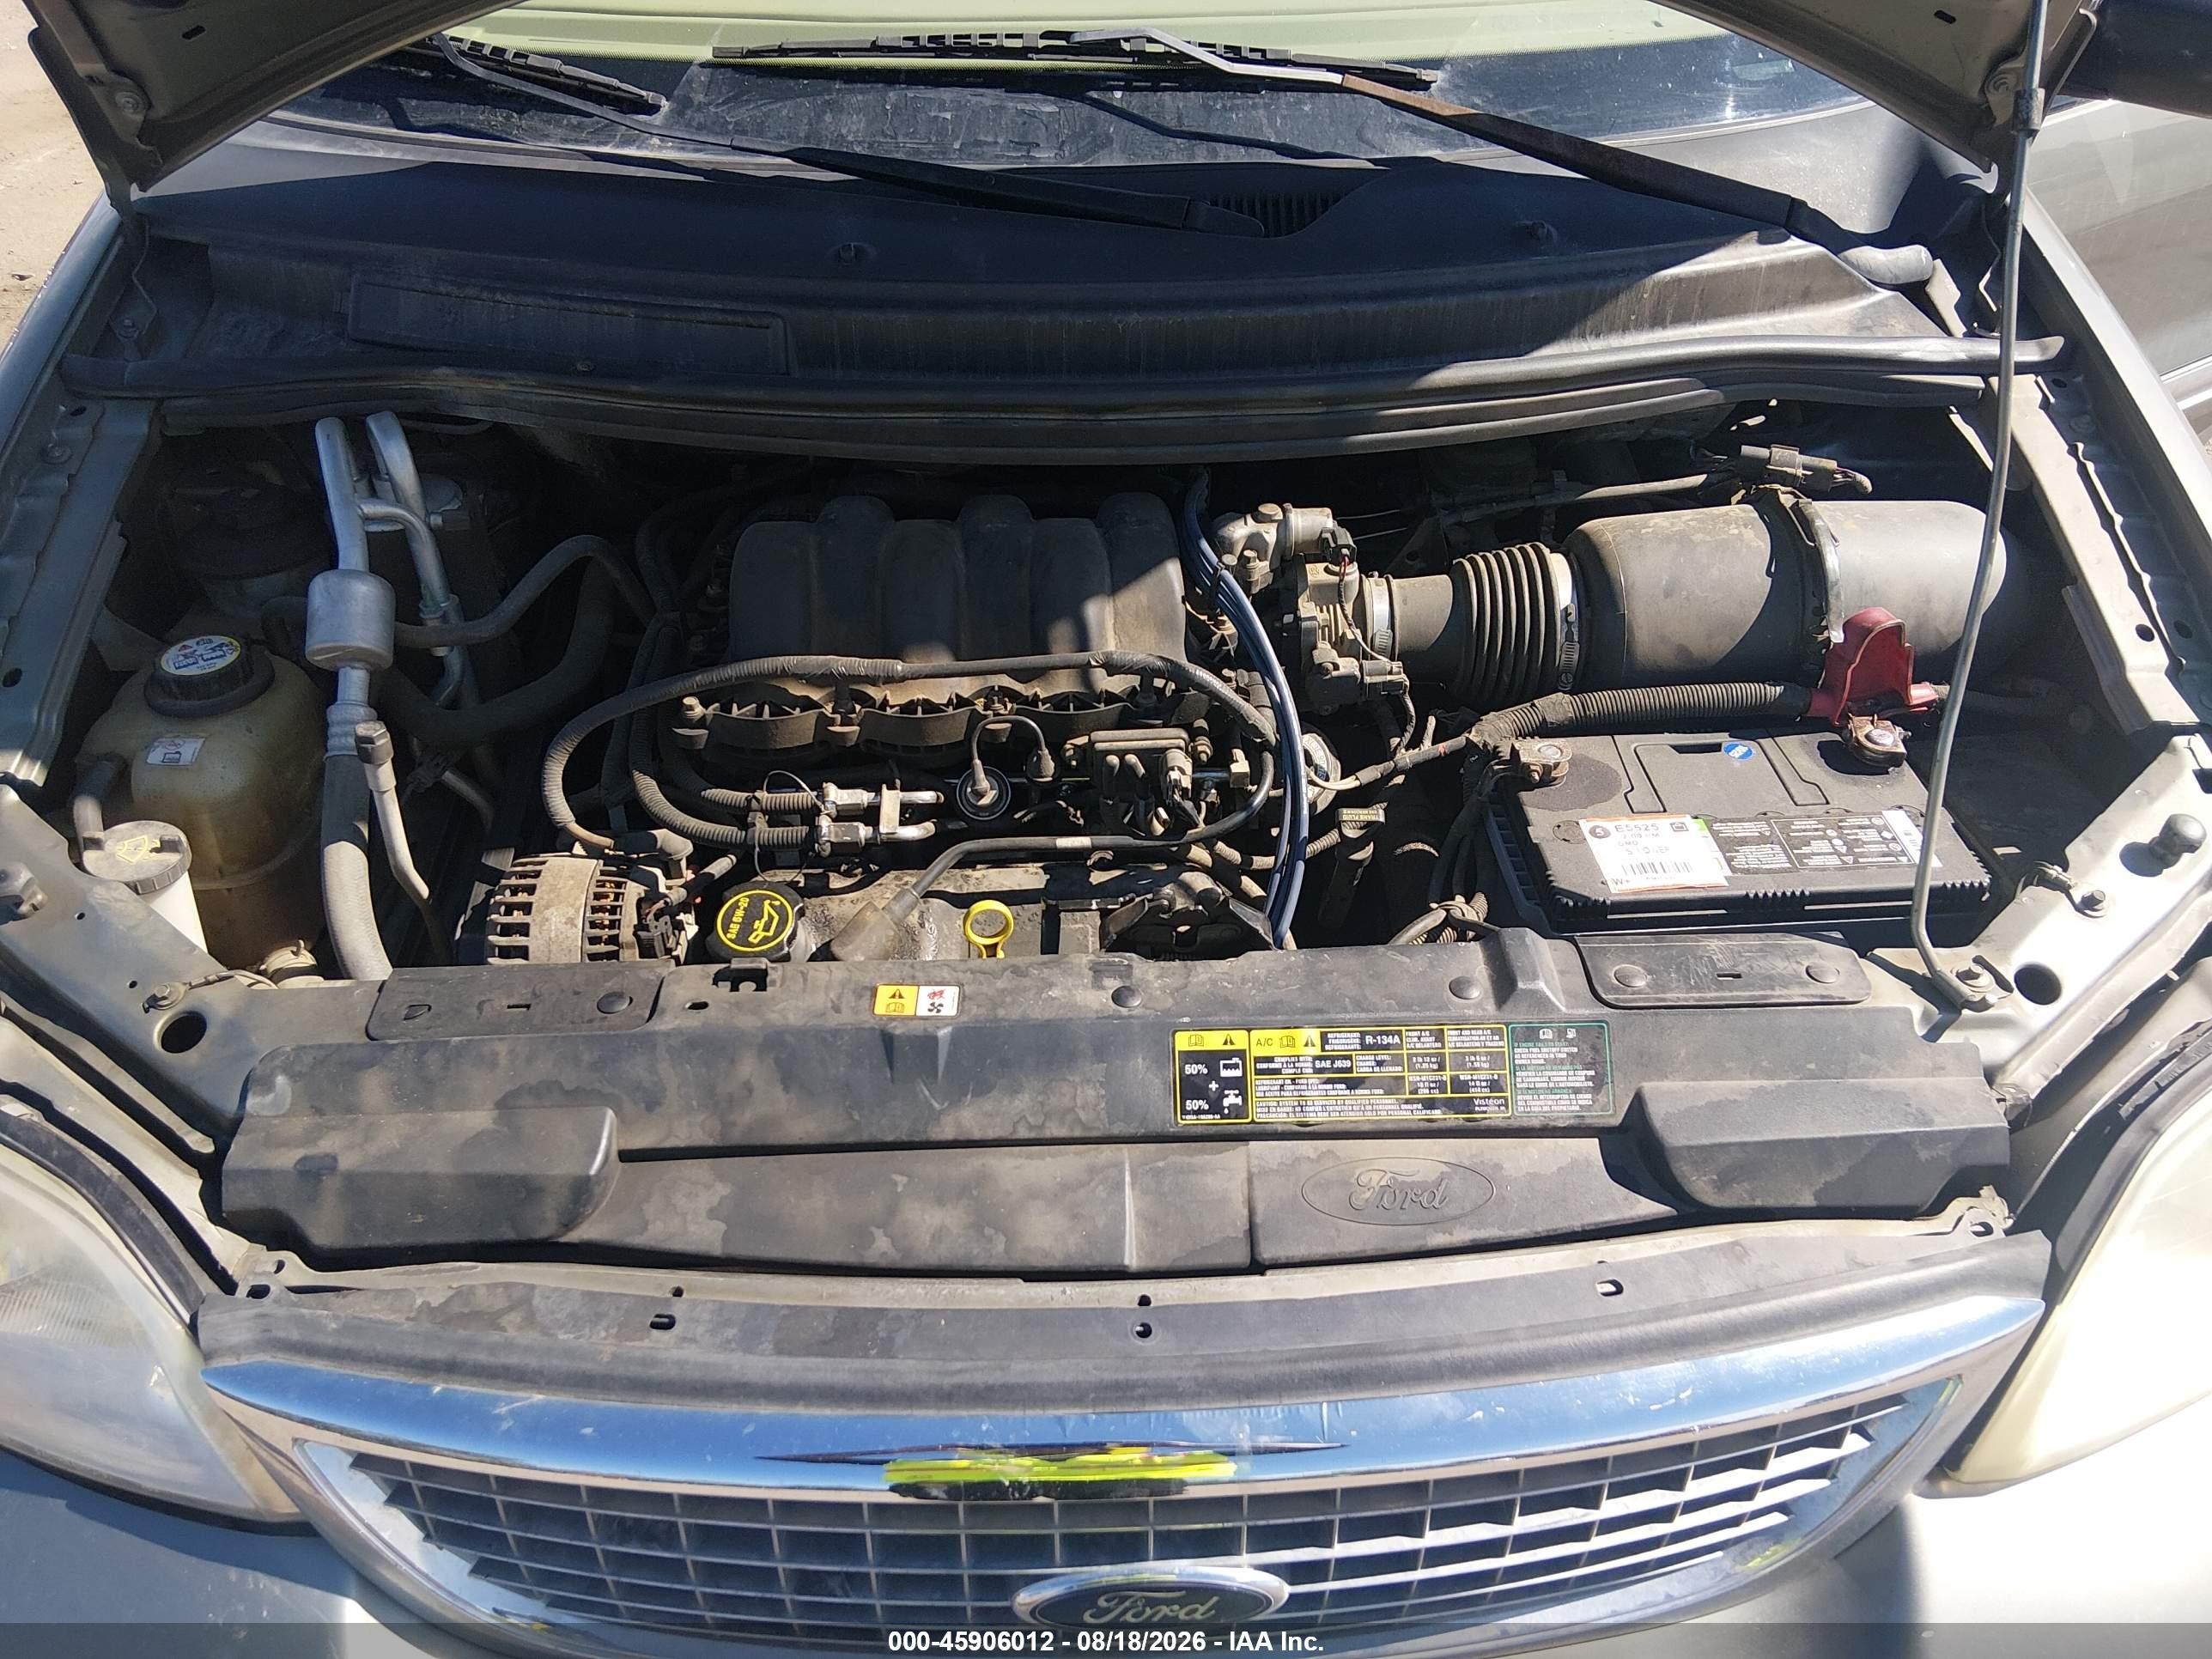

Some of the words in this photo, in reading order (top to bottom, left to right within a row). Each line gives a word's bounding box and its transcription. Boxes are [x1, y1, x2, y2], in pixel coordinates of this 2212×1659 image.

[1595, 828, 1604, 836] 5
[726, 923, 740, 939] SAE
[1255, 1038, 1273, 1047] A/C
[1365, 1035, 1401, 1045] R-134A
[1315, 1060, 1331, 1068] SAE
[1333, 1059, 1352, 1068] J639
[1184, 1064, 1208, 1075] 50%
[1185, 1099, 1209, 1110] 50%
[1347, 1168, 1450, 1211] Ford
[1082, 1590, 1220, 1623] Ford
